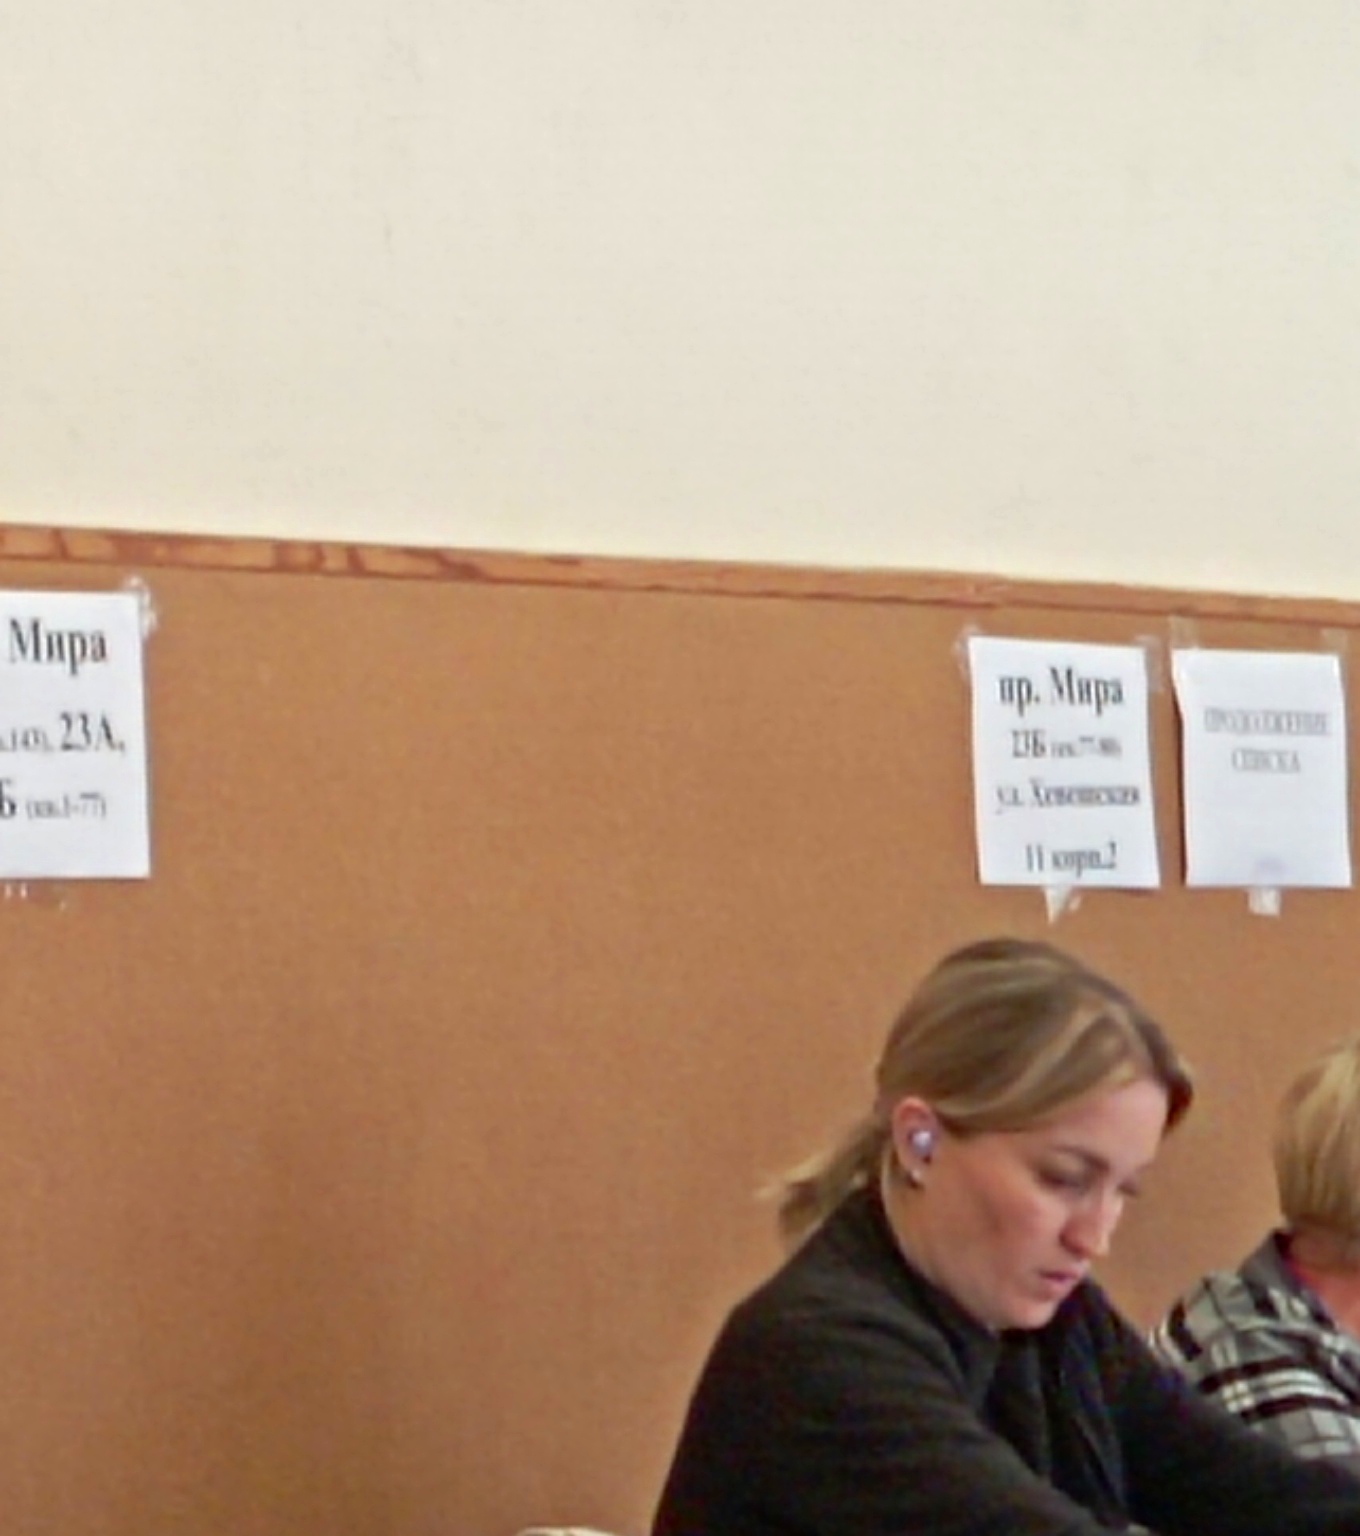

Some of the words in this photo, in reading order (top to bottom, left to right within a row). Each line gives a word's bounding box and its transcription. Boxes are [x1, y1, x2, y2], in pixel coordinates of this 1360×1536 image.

[9, 616, 108, 677] Мира
[998, 676, 1040, 716] пр.
[1048, 665, 1124, 717] Мира
[60, 711, 125, 756] 23А,
